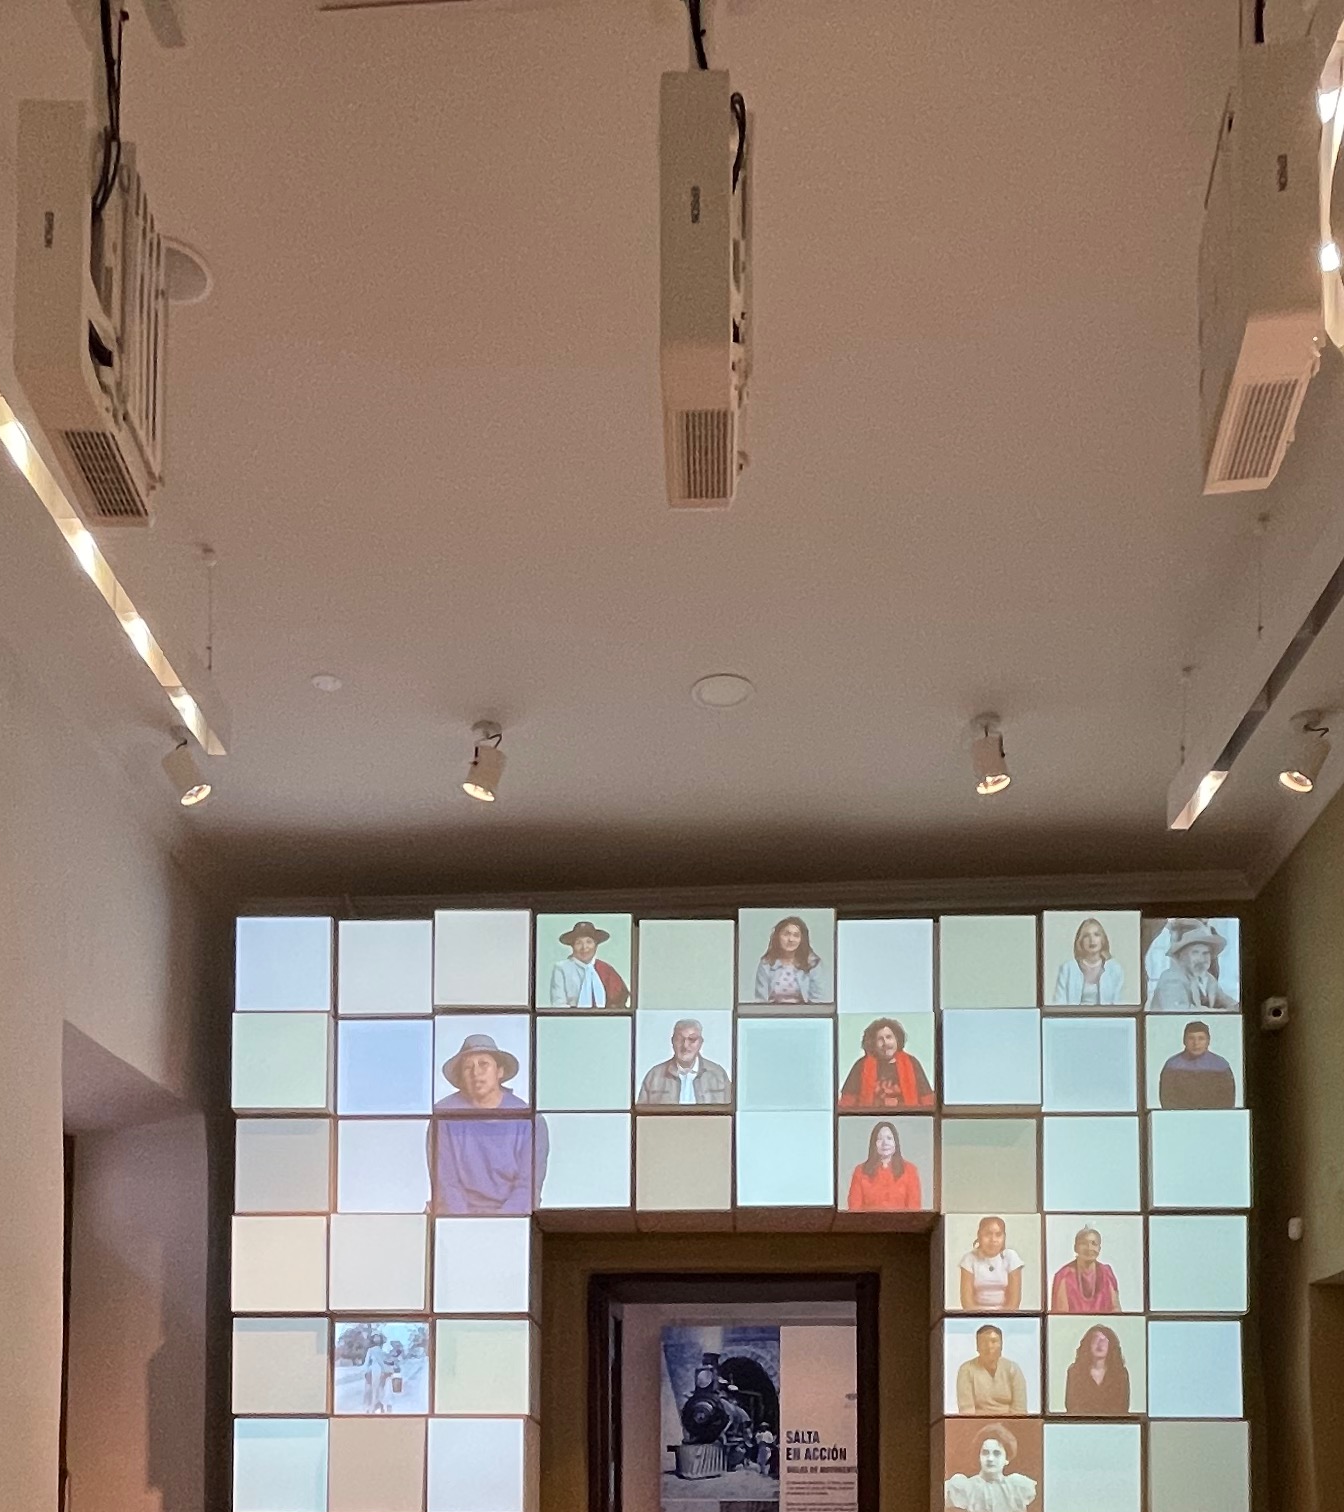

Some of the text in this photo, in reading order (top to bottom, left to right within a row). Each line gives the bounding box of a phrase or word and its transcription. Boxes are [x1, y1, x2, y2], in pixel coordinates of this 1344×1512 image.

[786, 1430, 820, 1444] SALTA
[786, 1444, 847, 1461] EN ACCIÓN
